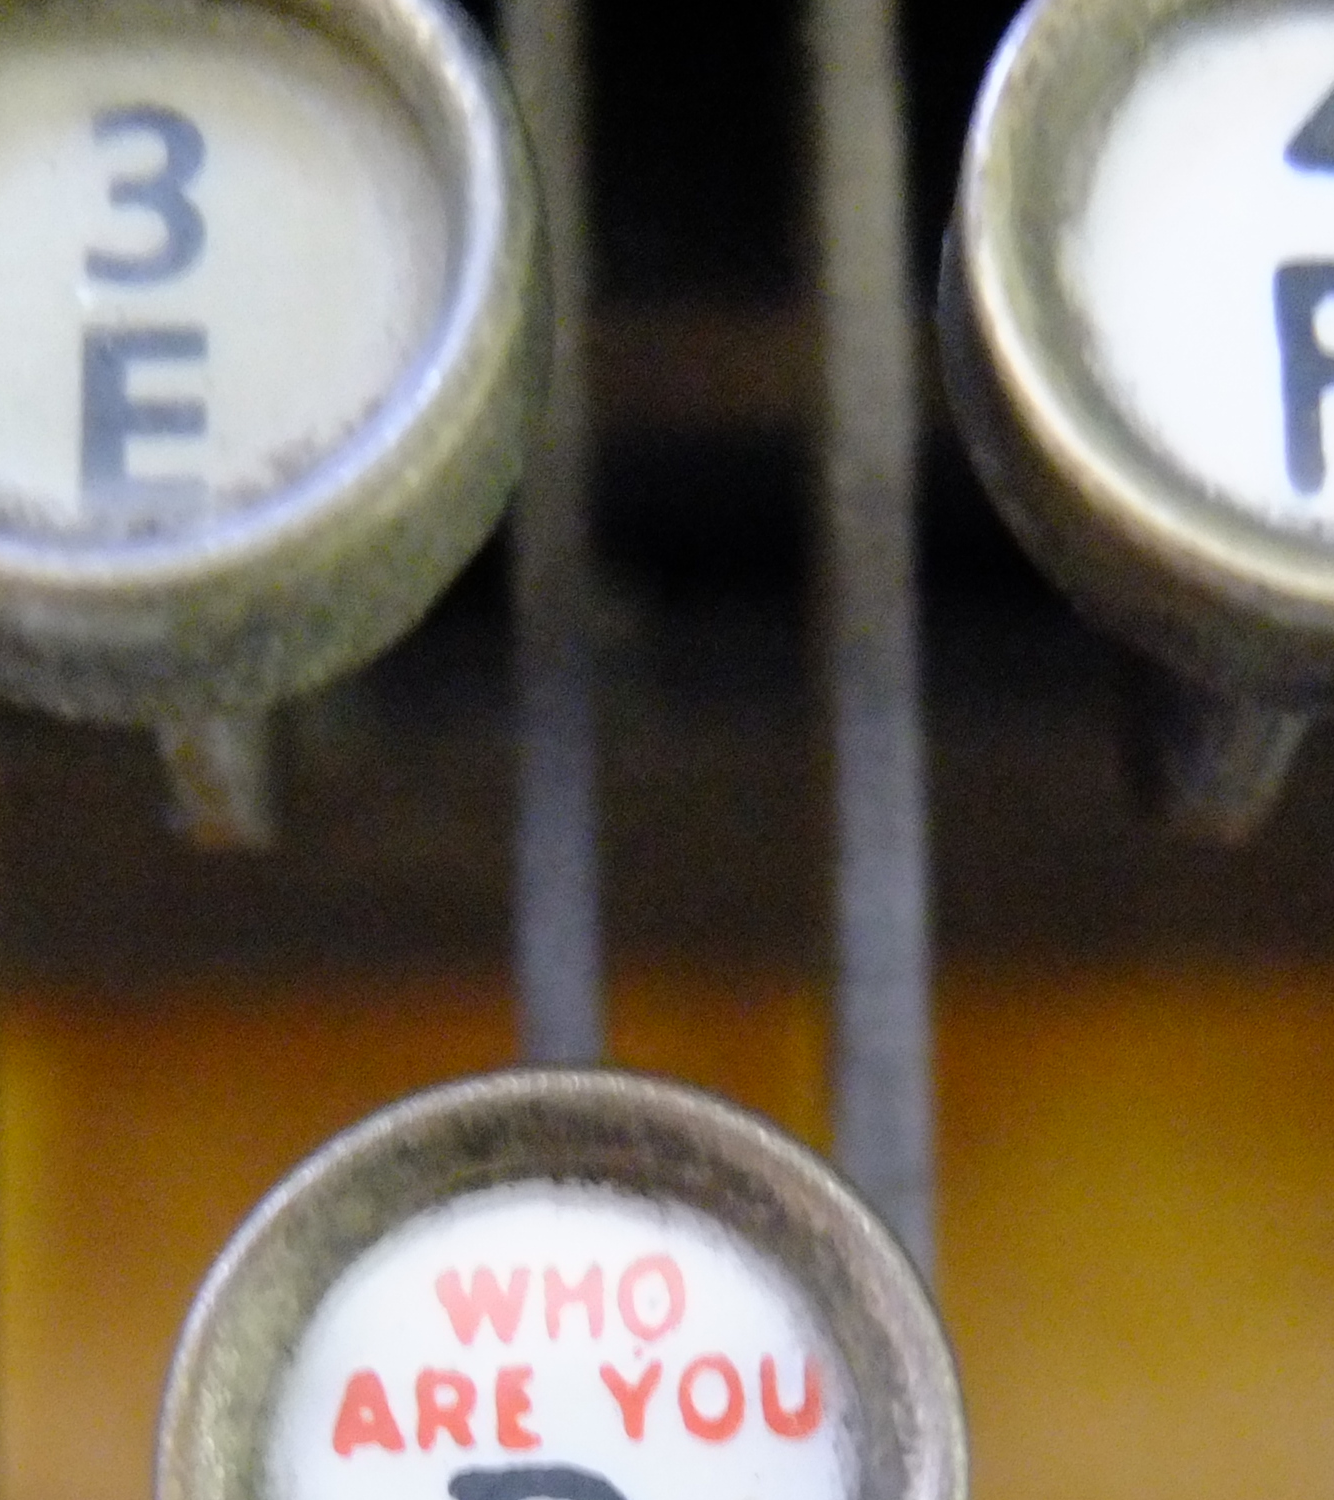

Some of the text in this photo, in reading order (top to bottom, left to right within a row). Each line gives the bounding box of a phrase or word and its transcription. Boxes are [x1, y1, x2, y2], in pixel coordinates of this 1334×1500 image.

[85, 102, 207, 283] 3
[79, 325, 208, 520] E
[434, 1253, 686, 1345] WHO
[332, 1353, 825, 1458] ARE YOU
